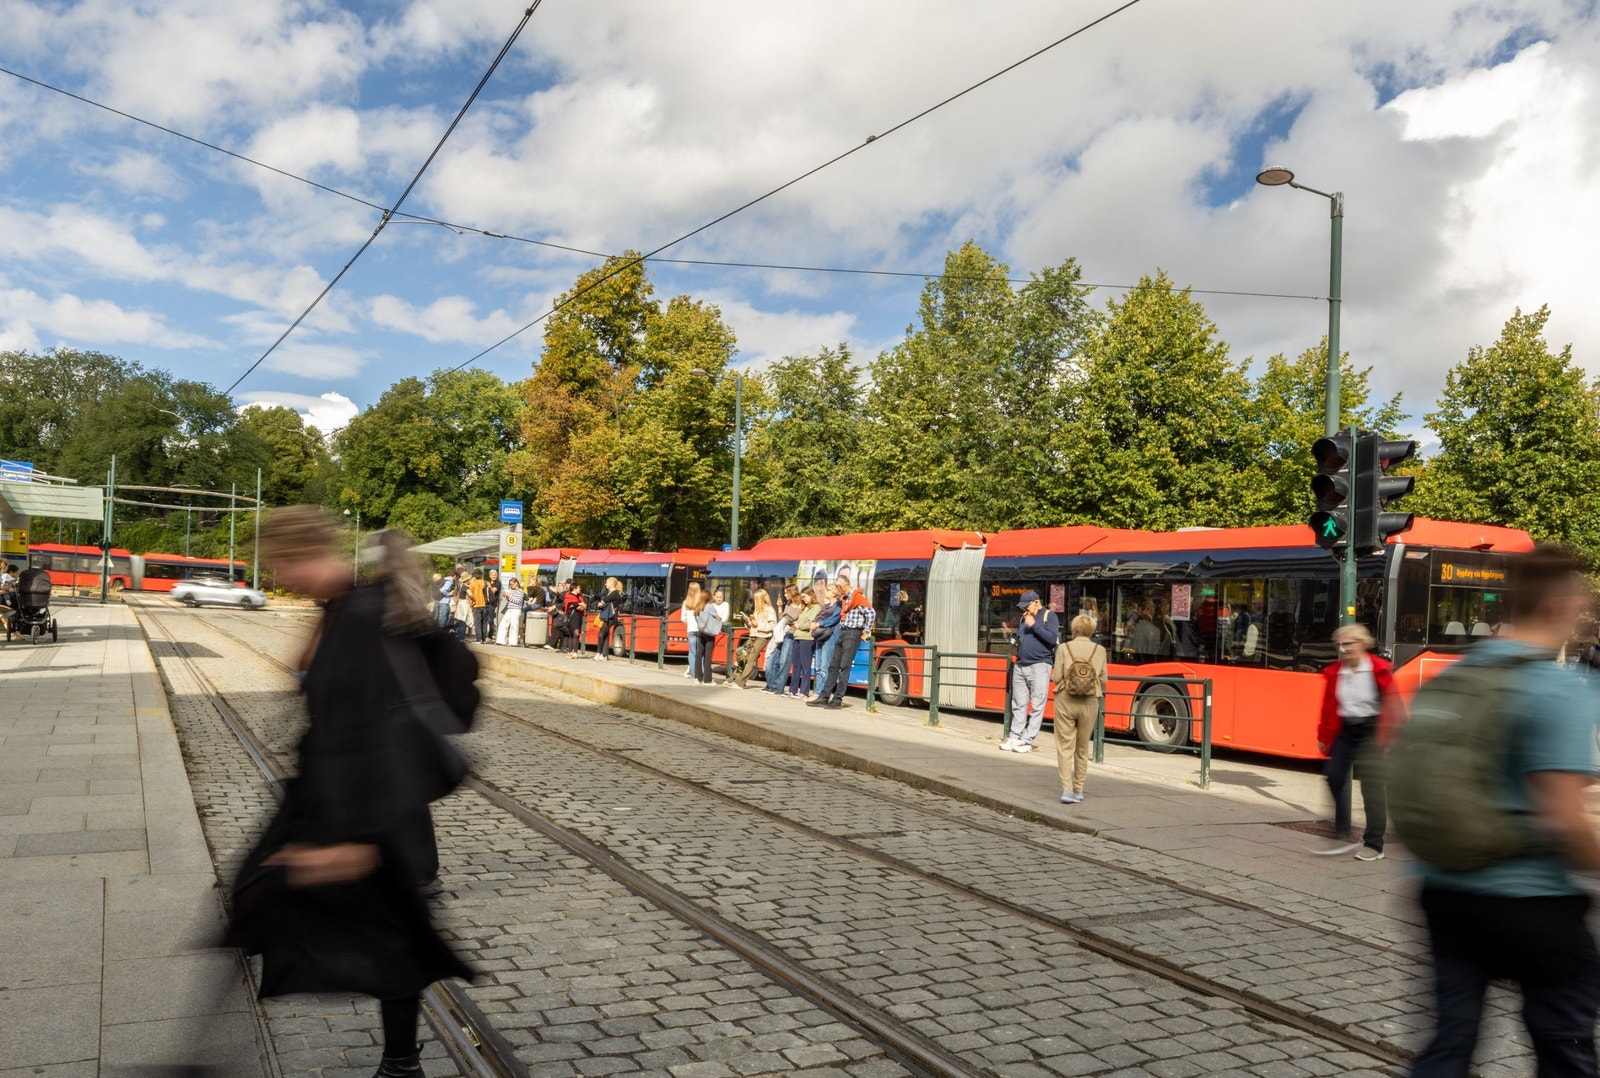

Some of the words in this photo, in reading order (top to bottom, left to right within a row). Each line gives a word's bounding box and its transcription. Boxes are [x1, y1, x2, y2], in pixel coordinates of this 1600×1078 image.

[509, 537, 515, 545] B
[1441, 564, 1453, 580] 30
[992, 585, 1000, 597] 30
